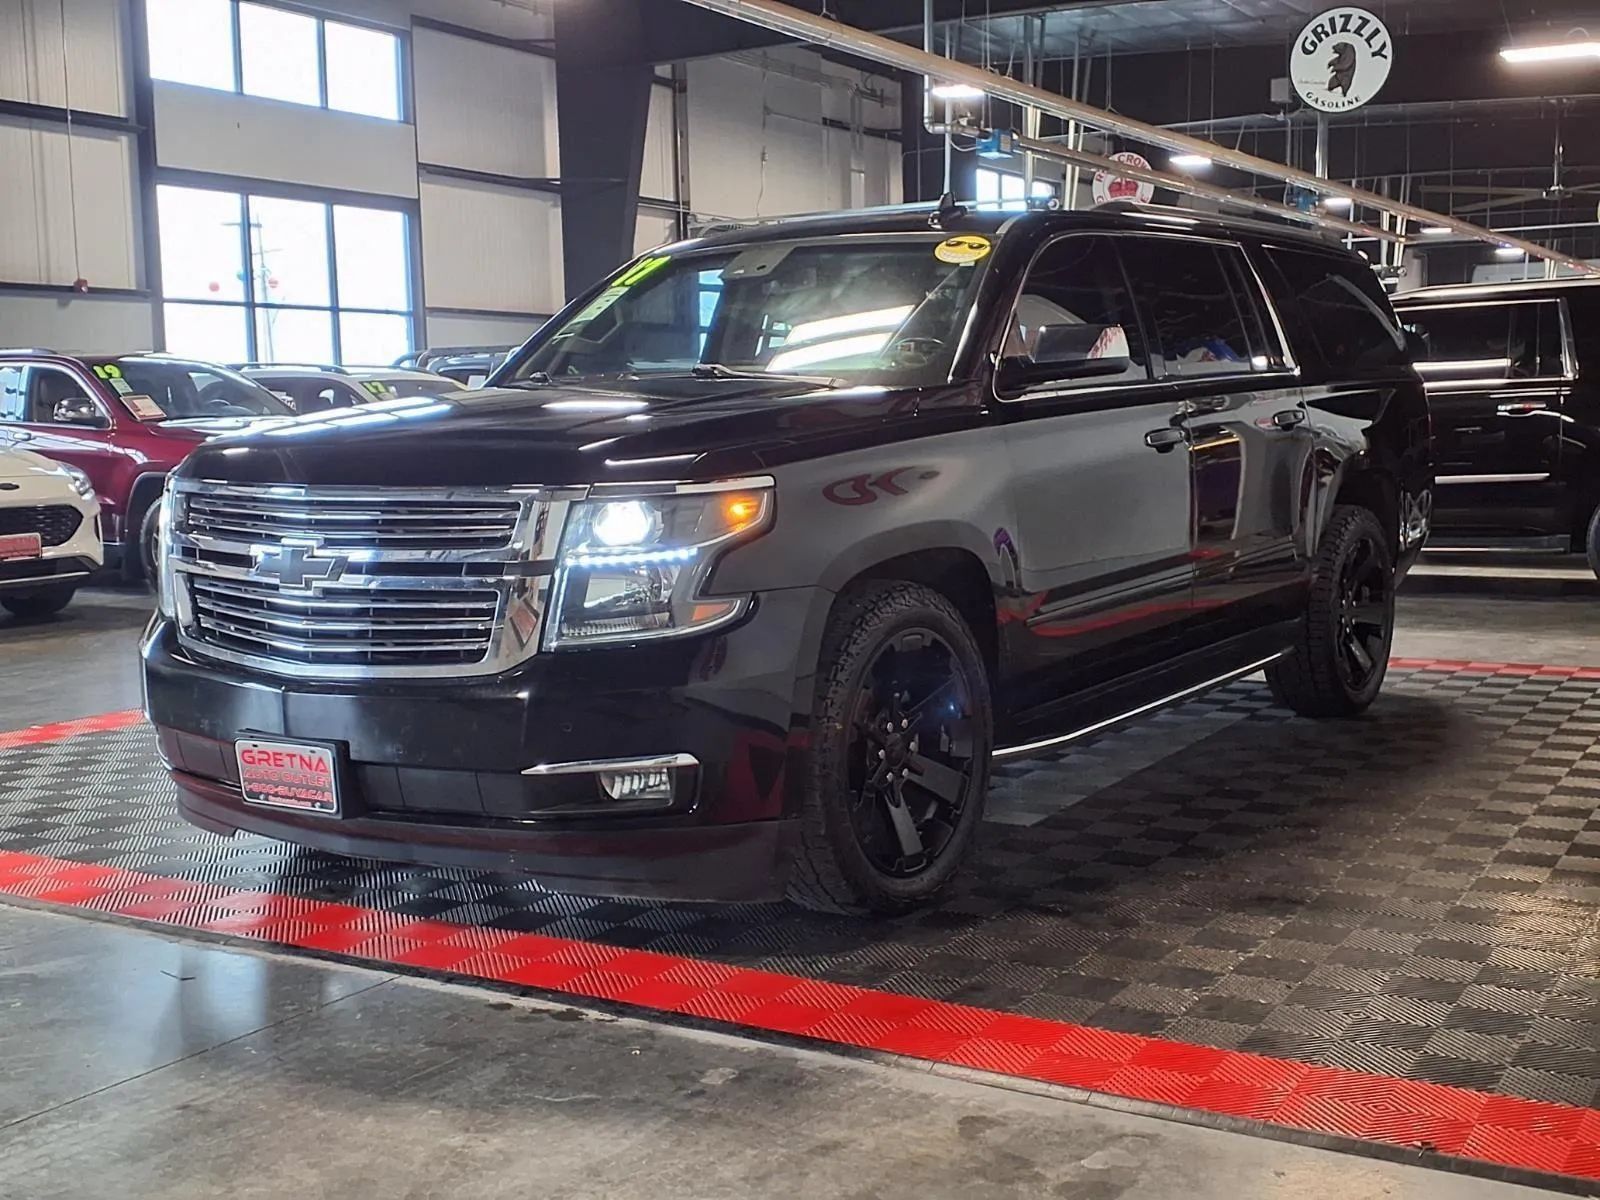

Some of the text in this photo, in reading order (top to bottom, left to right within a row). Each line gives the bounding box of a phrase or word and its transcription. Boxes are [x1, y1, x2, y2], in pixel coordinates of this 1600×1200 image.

[1301, 13, 1388, 60] GRIZZLY
[1305, 91, 1361, 108] GASOLINE
[92, 364, 122, 379] 19
[241, 749, 329, 774] GRETNA
[244, 768, 332, 788] AUTO OUTLET
